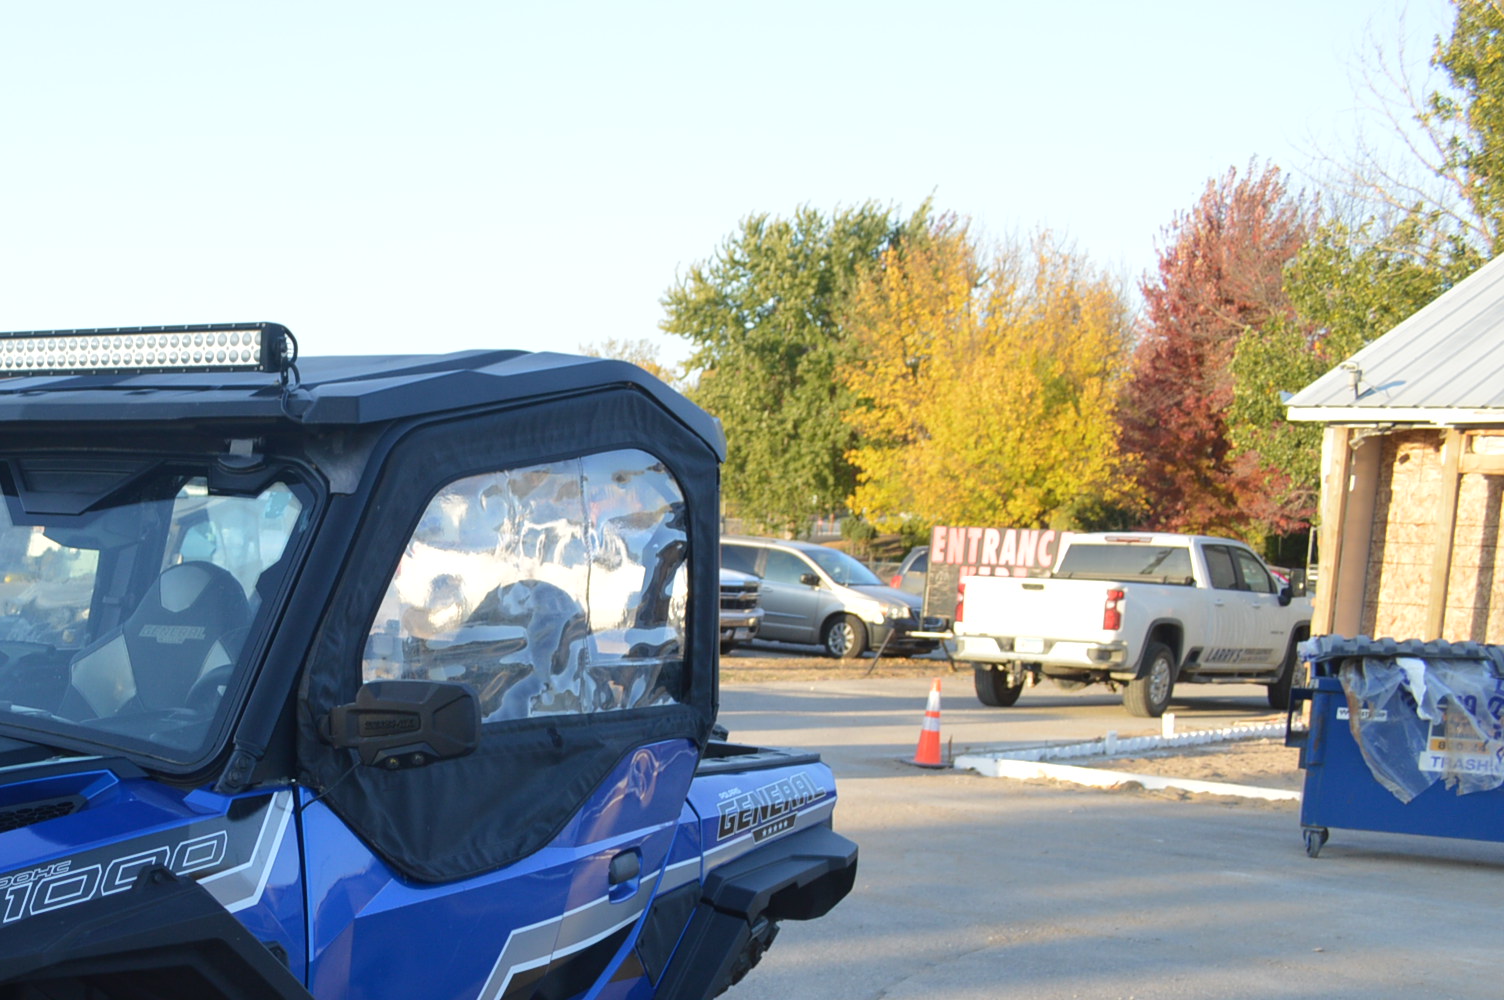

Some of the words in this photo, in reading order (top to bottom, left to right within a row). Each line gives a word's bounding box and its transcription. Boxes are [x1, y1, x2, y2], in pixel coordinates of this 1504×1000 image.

[931, 525, 1056, 568] ENTRANC
[717, 771, 826, 841] GENERAL
[3, 830, 229, 924] 1000
